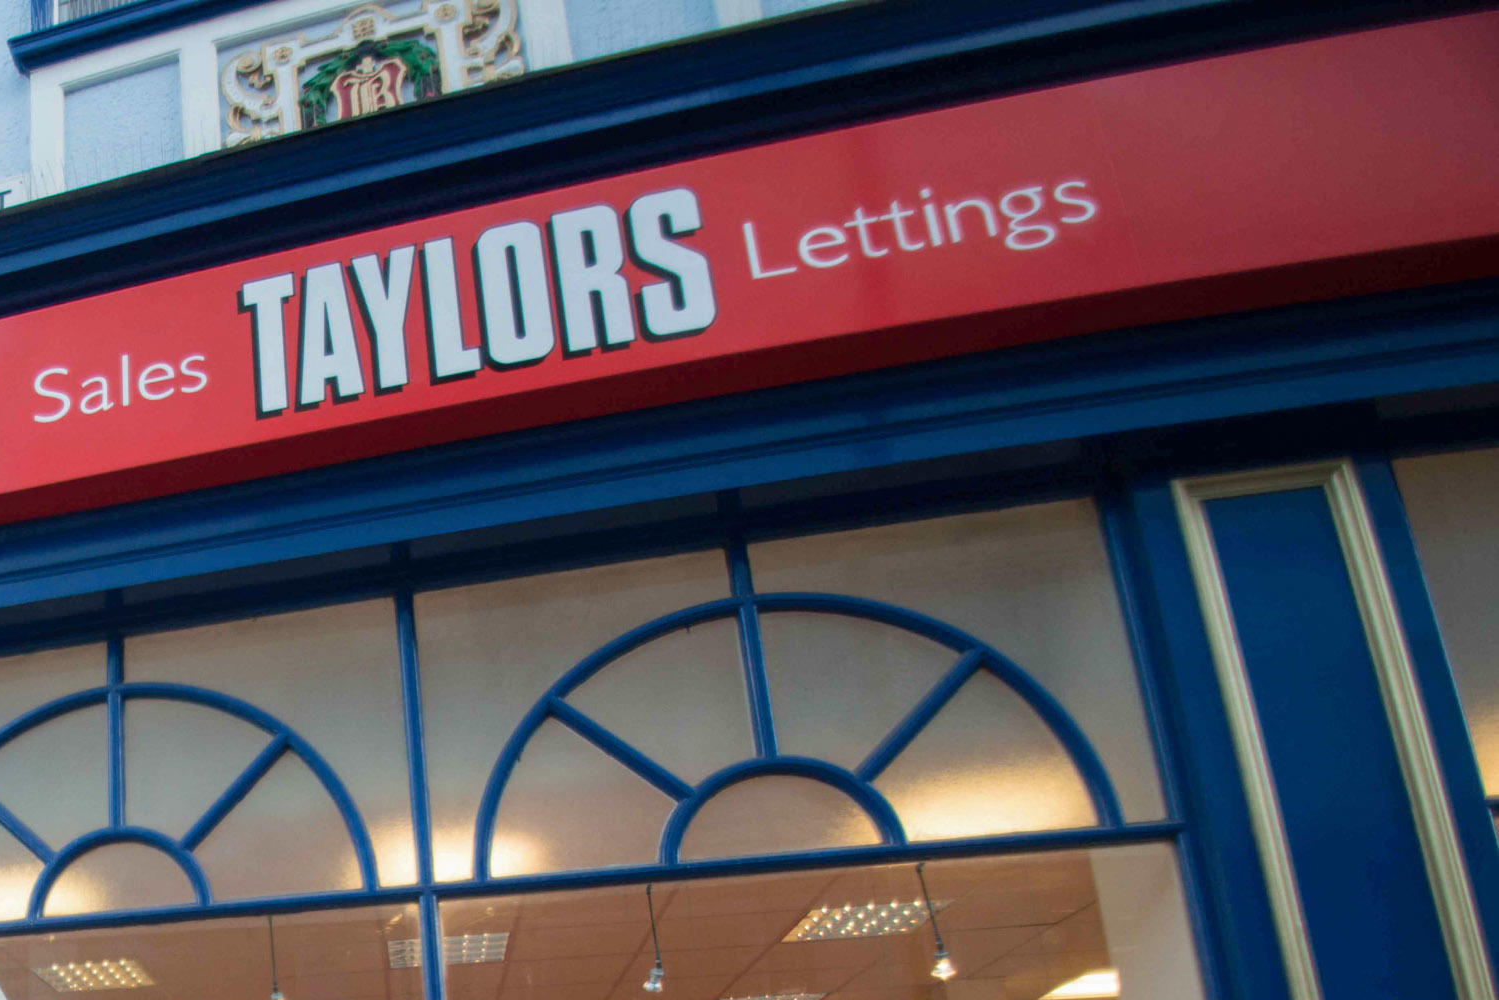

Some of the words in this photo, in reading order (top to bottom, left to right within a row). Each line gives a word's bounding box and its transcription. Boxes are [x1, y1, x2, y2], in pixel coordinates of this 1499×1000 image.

[32, 352, 208, 424] Sales
[240, 186, 718, 418] TAYLORS
[741, 179, 1097, 280] Lettings
